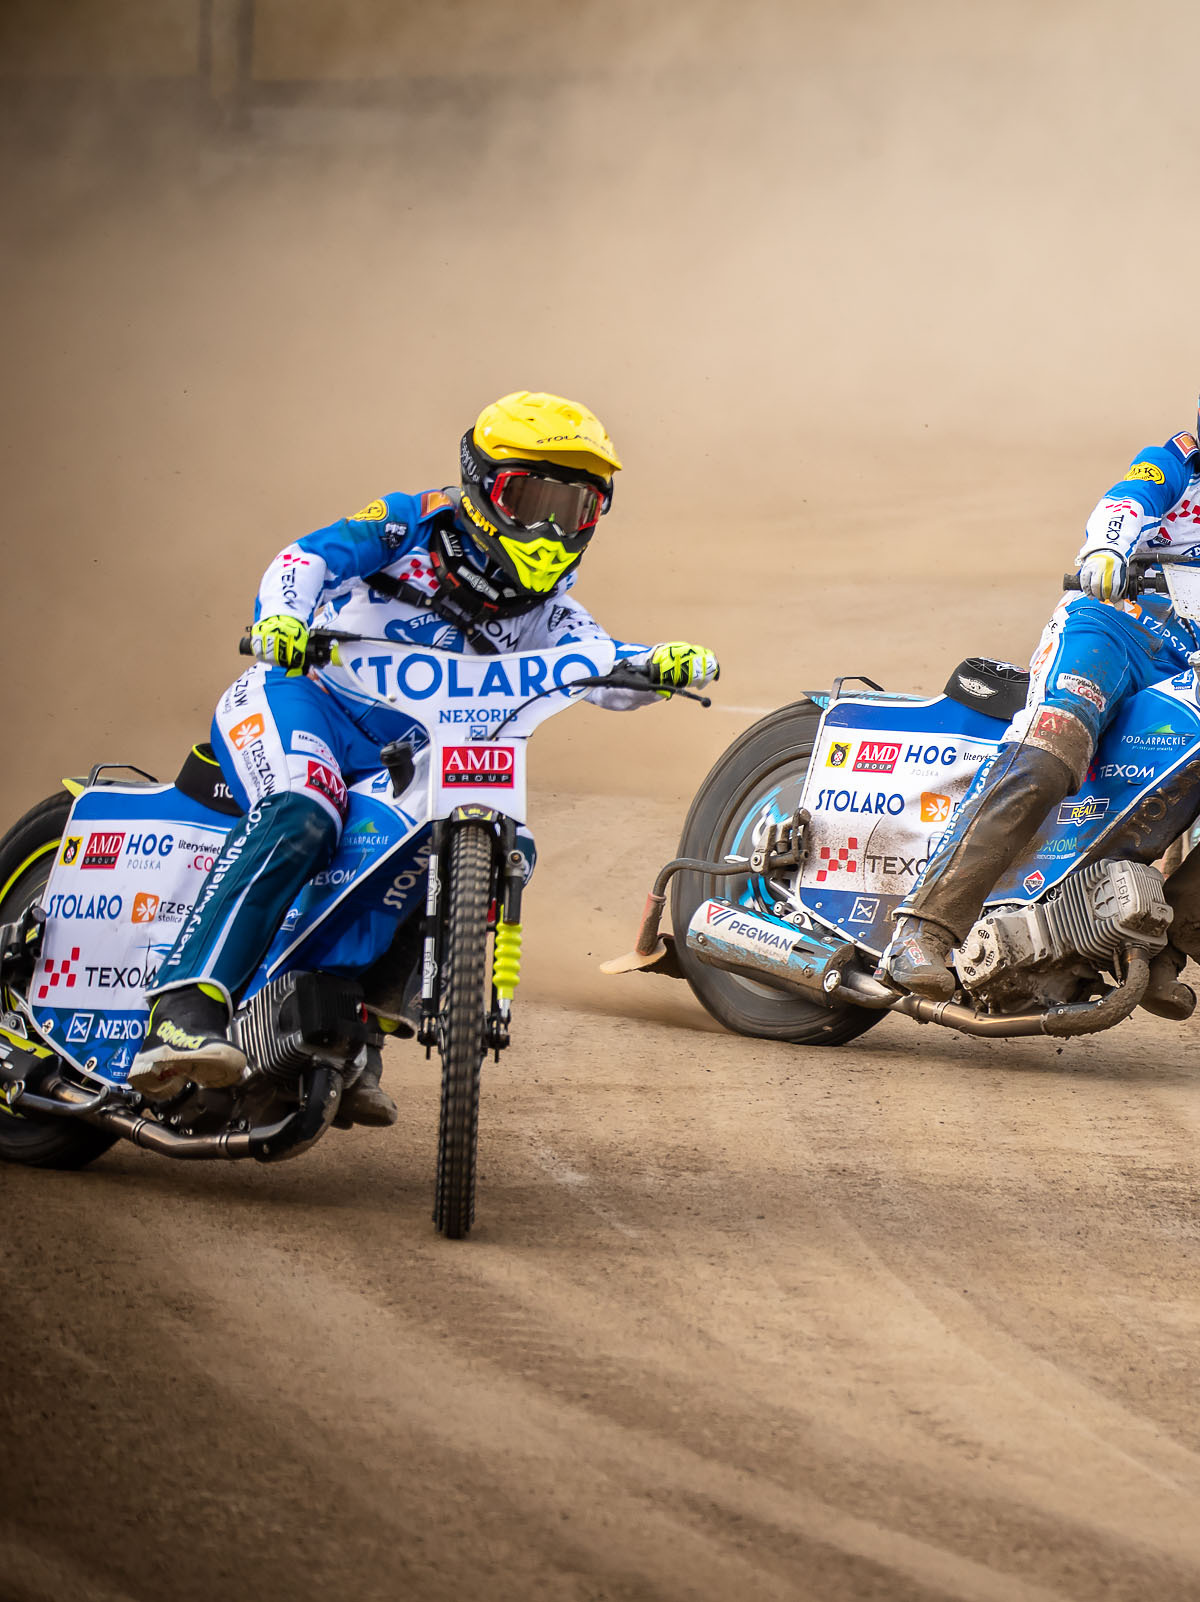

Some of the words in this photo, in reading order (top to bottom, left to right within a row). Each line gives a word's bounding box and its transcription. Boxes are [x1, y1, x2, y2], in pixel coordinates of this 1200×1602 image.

[439, 708, 518, 723] NEXORIS
[446, 750, 513, 771] AMD
[858, 744, 900, 762] AMD
[904, 745, 958, 765] HOG
[447, 774, 509, 782] GROUP
[1100, 764, 1155, 778] TEXOM
[311, 765, 348, 808] AM
[815, 789, 905, 815] STOLARO
[86, 834, 123, 854] AMD
[126, 834, 174, 856] HOG
[1035, 837, 1078, 851] XIONA
[85, 857, 116, 865] GROUP
[127, 859, 161, 870] POLSKA
[866, 854, 929, 876] TEXO
[383, 836, 434, 909] STOLAR
[46, 894, 122, 920] STOLARO
[160, 901, 194, 916] rzes
[728, 920, 794, 951] PEGWAN
[95, 1018, 149, 1040] NEXO
